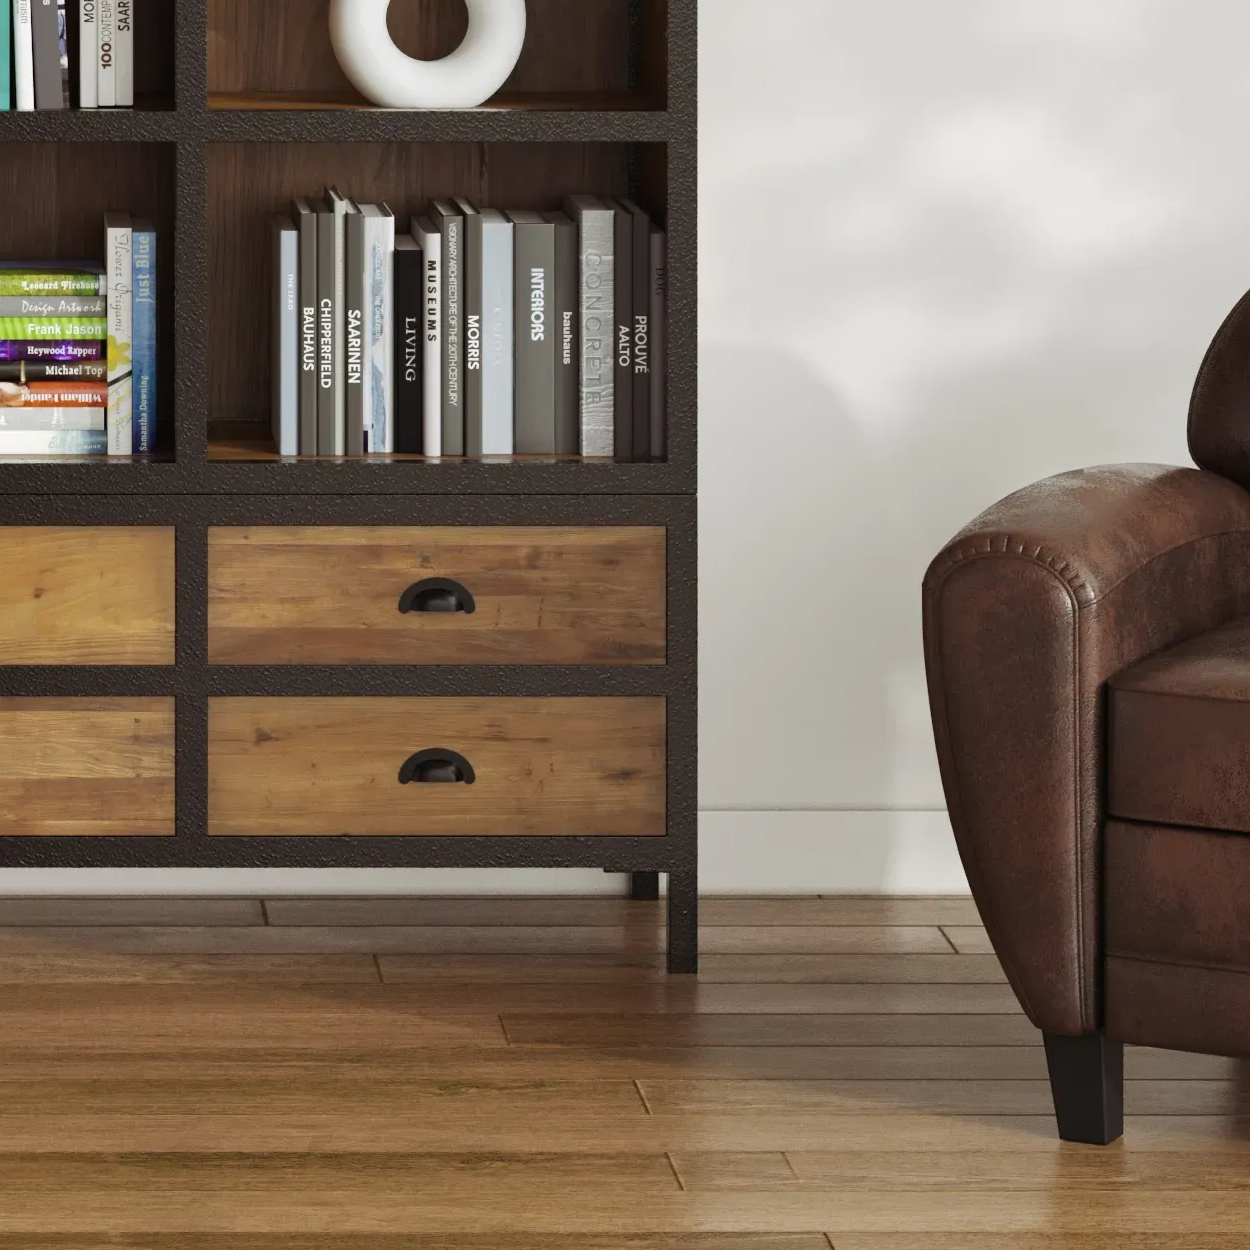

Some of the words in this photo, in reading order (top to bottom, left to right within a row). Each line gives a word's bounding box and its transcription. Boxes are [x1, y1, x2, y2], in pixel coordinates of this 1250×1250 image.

[115, 234, 130, 277] Flower
[134, 236, 150, 268] Blue
[448, 222, 457, 259] VISIONARY
[21, 280, 59, 291] Leonard
[136, 274, 153, 303] Just
[427, 260, 437, 342] MUSEUMS
[447, 258, 457, 316] ARCHITECTURE
[530, 268, 545, 341] INTERIORS
[21, 300, 56, 316] Design
[58, 300, 102, 314] Artwork
[110, 283, 129, 331] Origami
[447, 316, 458, 327] OF
[584, 250, 602, 404] CONCRETE
[28, 323, 62, 335] Frank
[65, 323, 102, 335] Jason
[303, 307, 315, 371] BAUHAUS
[320, 298, 332, 389] CHIPPERFIELD
[347, 309, 361, 384] SAARINEN
[405, 316, 416, 382] LIVING
[447, 327, 458, 343] THE
[467, 315, 480, 370] MORRIS
[562, 311, 573, 365] bauhaus
[618, 325, 630, 367] AALTO
[634, 315, 650, 374] PROUVÉ
[27, 345, 65, 357] Heywood
[67, 346, 97, 357] Rapper
[45, 364, 83, 376] Michael
[448, 344, 458, 366] 20TH
[139, 375, 150, 410] Downing
[448, 367, 458, 407] CENTURY
[138, 413, 148, 451] Samantha
